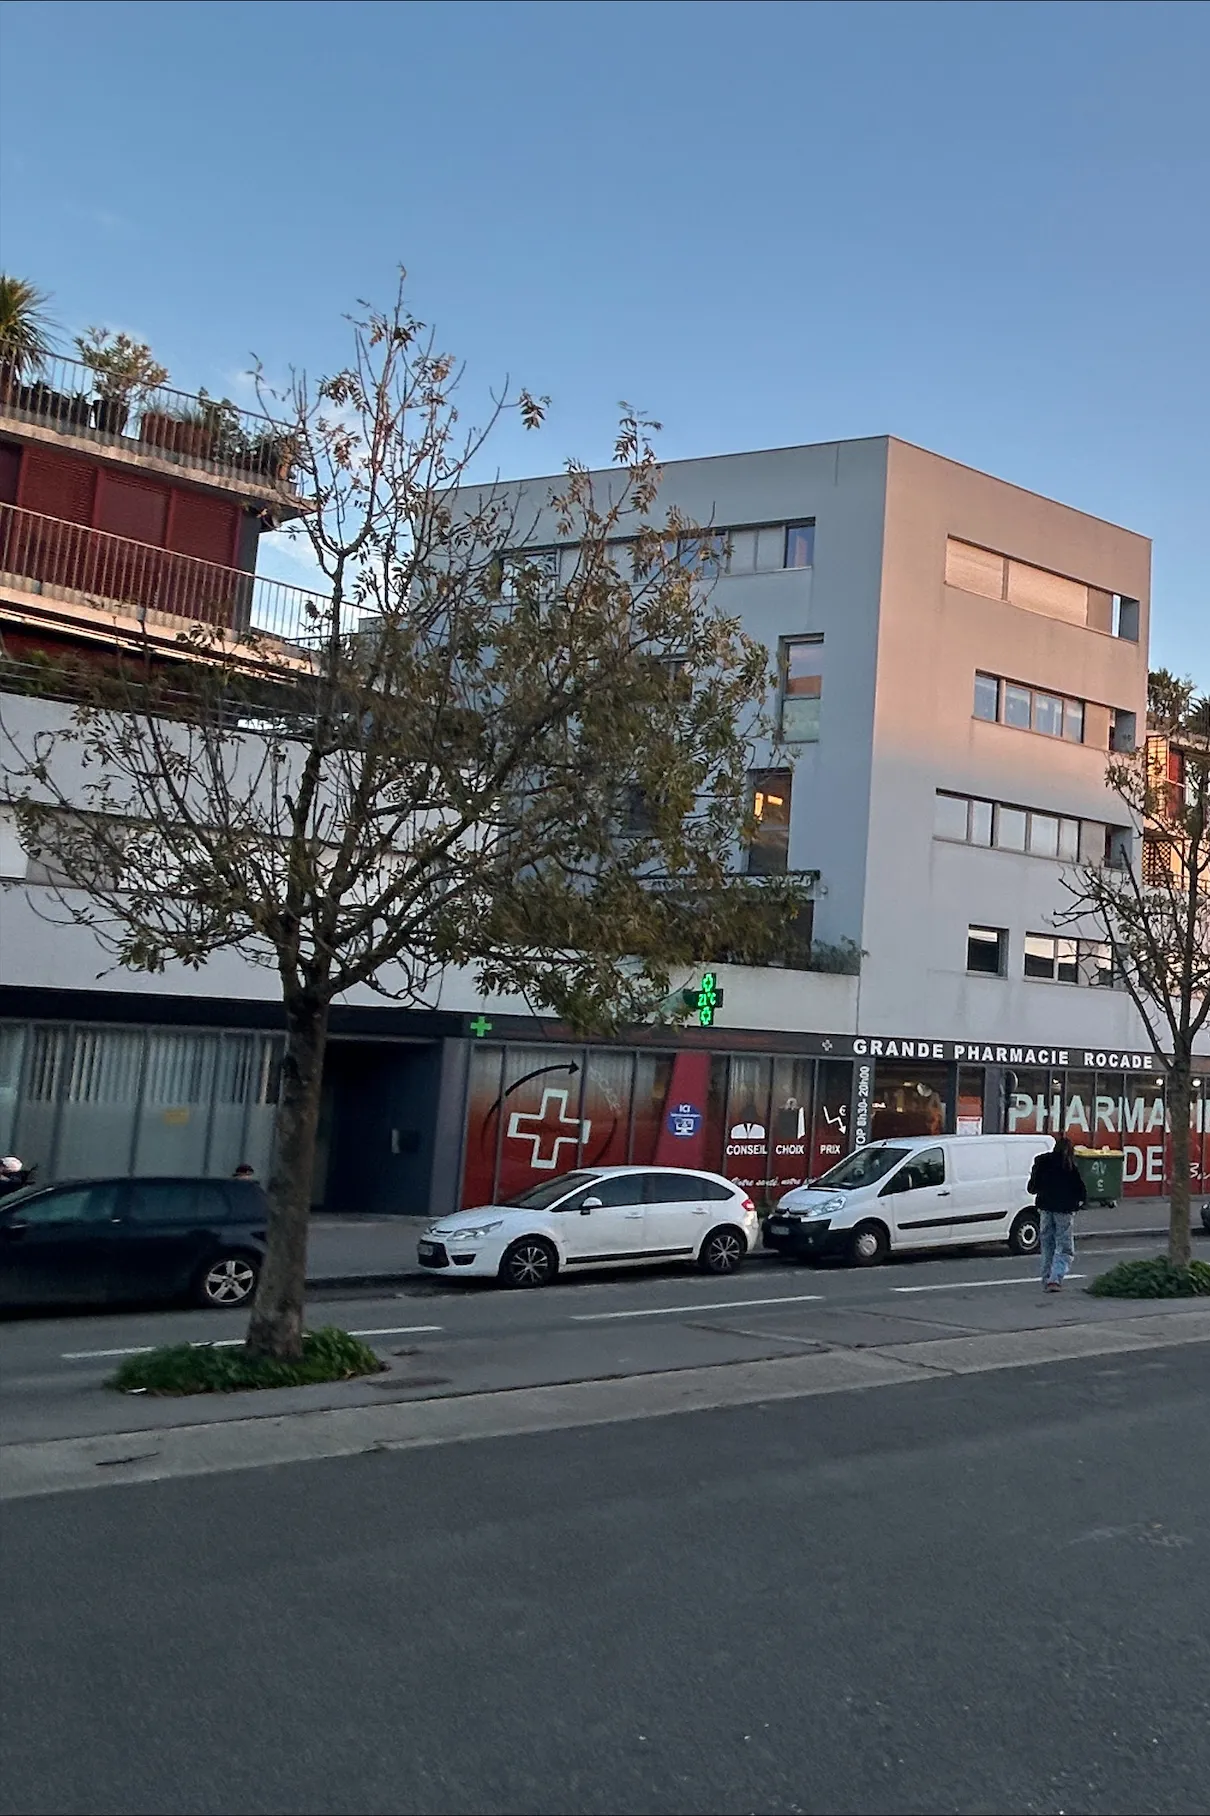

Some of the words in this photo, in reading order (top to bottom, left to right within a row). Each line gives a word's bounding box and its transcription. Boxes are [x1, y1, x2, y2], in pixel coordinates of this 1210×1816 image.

[853, 1039, 944, 1058] GRANDE
[954, 1044, 1069, 1065] PHARMACIE
[1083, 1052, 1152, 1069] ROCADE
[679, 1104, 691, 1113] ICI
[855, 1128, 866, 1150] TOP
[726, 1144, 768, 1155] CONSEIL
[775, 1144, 805, 1155] CHOIX
[820, 1144, 841, 1155] PRIX
